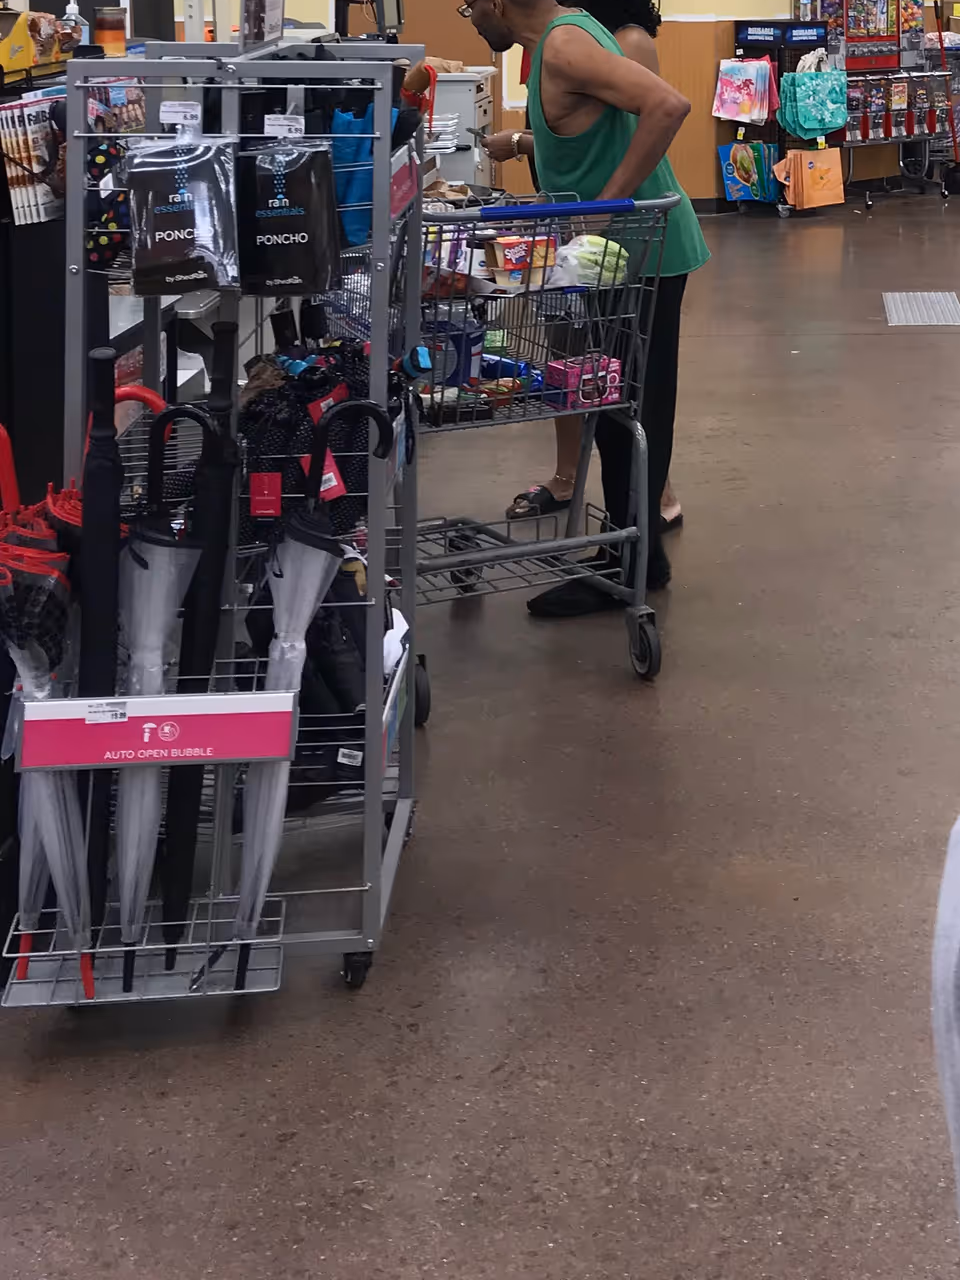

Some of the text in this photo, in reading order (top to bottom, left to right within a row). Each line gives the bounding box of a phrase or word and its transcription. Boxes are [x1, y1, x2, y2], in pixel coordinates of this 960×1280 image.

[255, 206, 305, 218] essentials
[256, 232, 309, 246] PONCHO
[104, 747, 213, 760] AUTO OPEN BUBBLE
